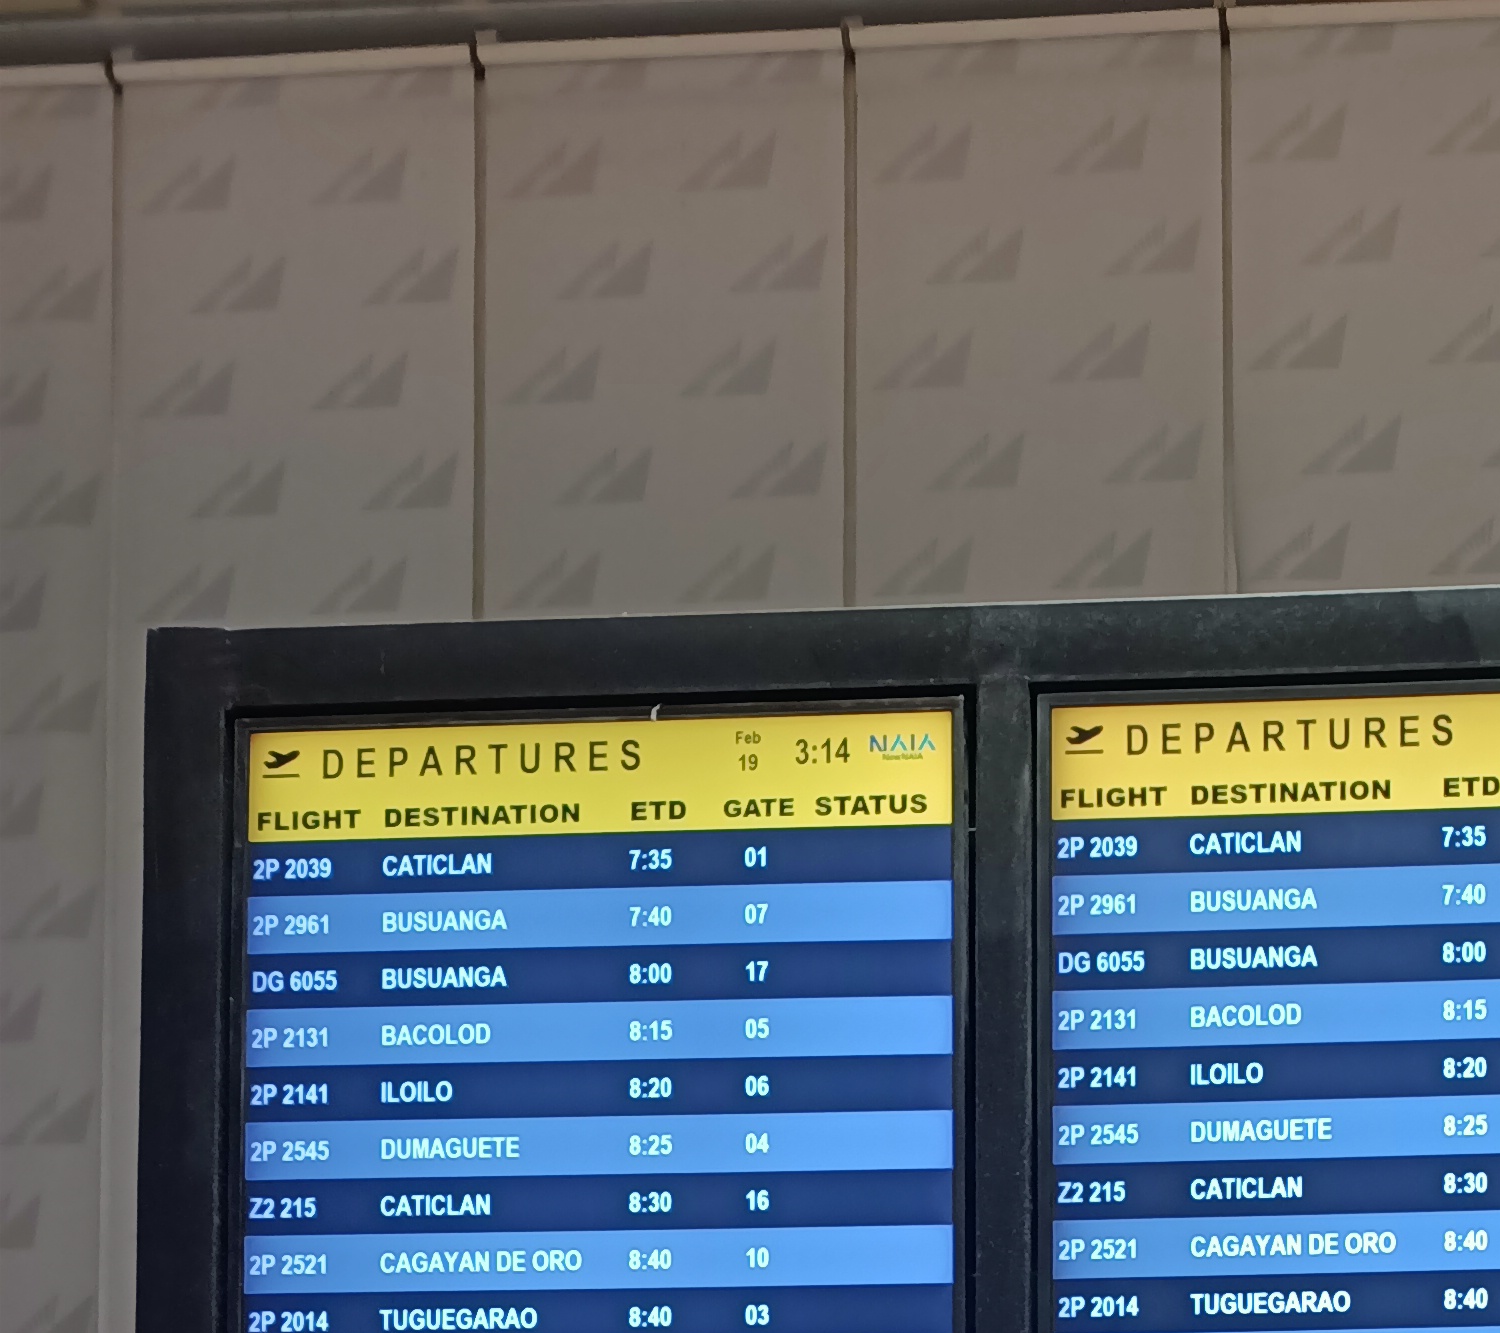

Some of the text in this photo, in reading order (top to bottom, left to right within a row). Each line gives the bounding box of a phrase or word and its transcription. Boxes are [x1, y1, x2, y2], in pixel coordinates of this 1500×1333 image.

[735, 730, 762, 745] Feb
[795, 736, 851, 765] 3:14
[869, 733, 936, 752] NAIA
[1126, 713, 1453, 756] DEPARTURES
[322, 739, 641, 780] DEPARTURES
[738, 753, 759, 772] 19
[1060, 785, 1168, 809] FLIGHT
[1190, 779, 1391, 806] DESTINATION
[1443, 776, 1500, 798] ETD
[257, 793, 928, 832] FLIGHT DESTINATION ETD GATE STATUS
[253, 846, 767, 880] 2P 2039 CATICLAN 7:35 01
[1058, 894, 1085, 916] 2P
[1090, 893, 1136, 915] 2961
[1190, 887, 1318, 913] BUSUANGA
[1442, 883, 1486, 906] 7:40
[252, 960, 769, 993] DG 6055 BUSUANGA 8:00 17
[1058, 1009, 1085, 1031] 2P
[1090, 1008, 1136, 1030] 2131
[1190, 1003, 1302, 1028] BACOLOD
[1442, 998, 1487, 1021] 8:15
[251, 1132, 770, 1162] 2P 2545 DUMAGUETE 8:25 04
[1057, 1181, 1084, 1203] Z2
[1089, 1180, 1126, 1203] 215
[1190, 1176, 1303, 1200] CATICLAN
[1443, 1171, 1488, 1194] 8:30
[250, 1246, 770, 1275] 2P 2521 CAGAYAN DE ORO 8:40 10
[1058, 1296, 1086, 1318] 2P
[1090, 1295, 1140, 1318] 2014
[1189, 1290, 1351, 1315] TUGUEGARAO
[1443, 1287, 1489, 1310] 8:40
